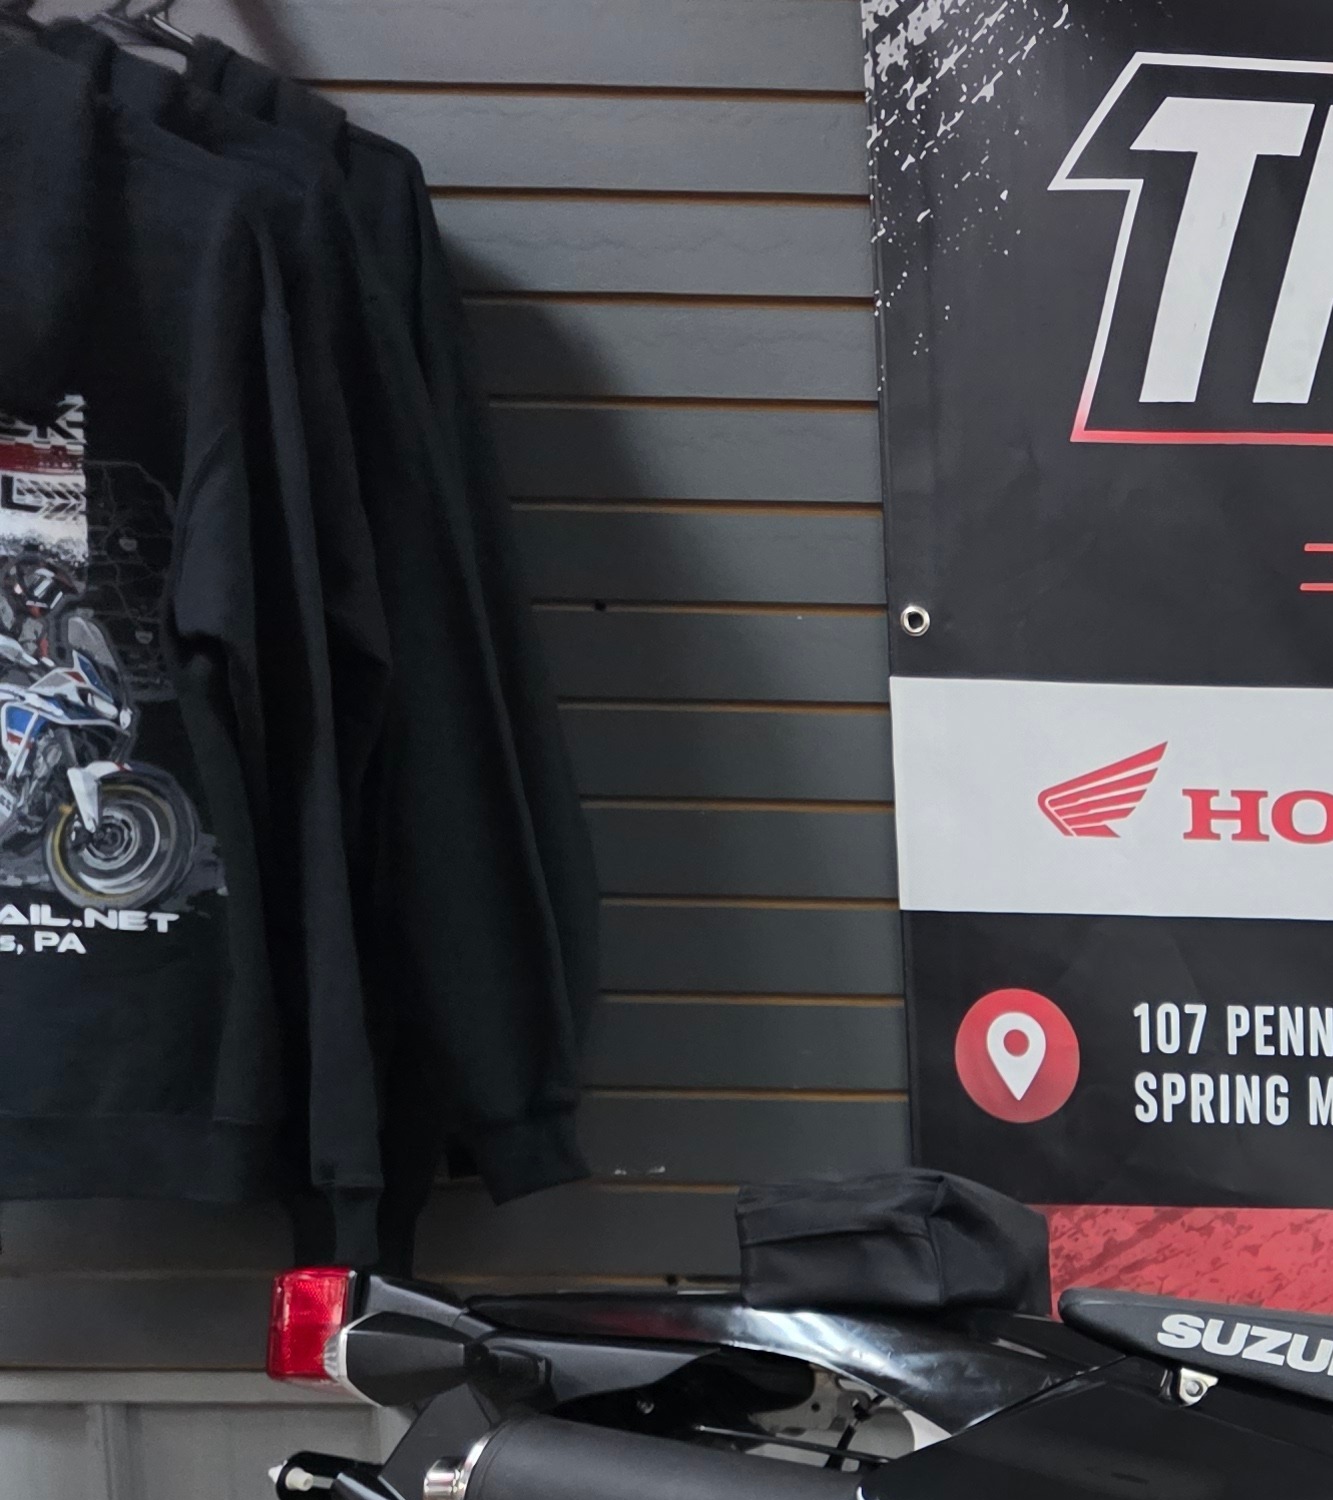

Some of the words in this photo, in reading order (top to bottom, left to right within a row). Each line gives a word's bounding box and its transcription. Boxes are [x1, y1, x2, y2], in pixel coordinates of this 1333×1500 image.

[34, 930, 87, 955] PA
[1133, 1002, 1207, 1054] 107
[1134, 1073, 1289, 1125] SPRING
